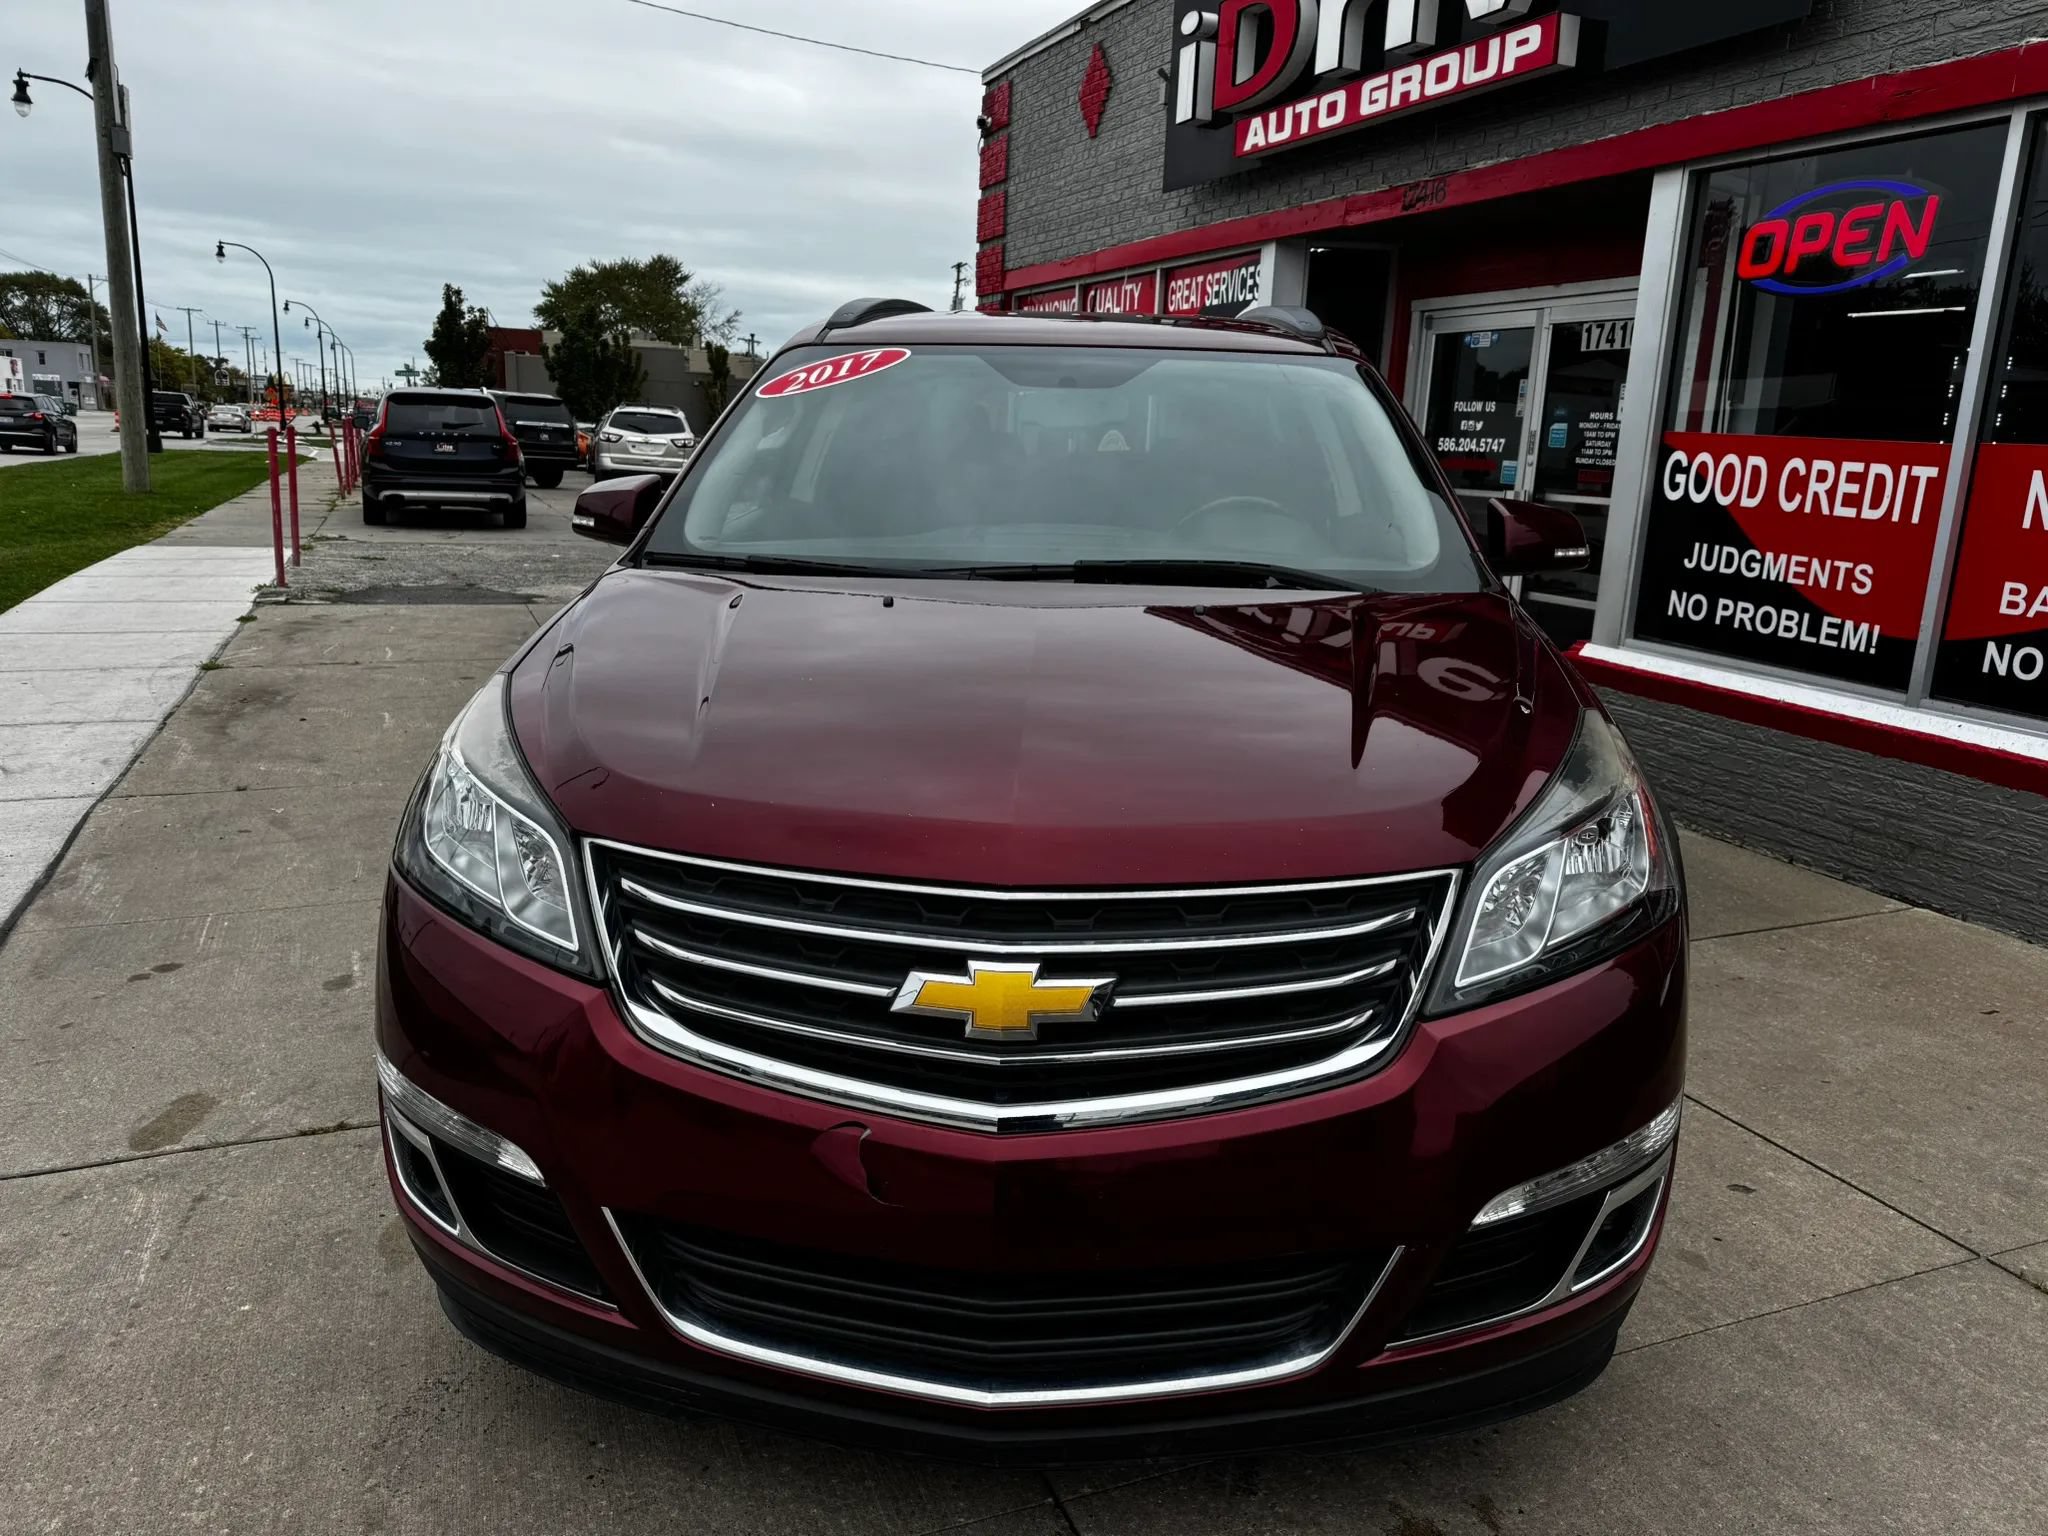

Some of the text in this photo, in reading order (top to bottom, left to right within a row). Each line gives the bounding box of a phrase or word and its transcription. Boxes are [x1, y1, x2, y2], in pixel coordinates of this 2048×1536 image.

[1243, 24, 1542, 152] AUTO GROUP
[1737, 194, 1940, 280] OPEN
[1168, 263, 1261, 312] GREAT SERVICES
[1585, 321, 1634, 350] 1741
[782, 351, 883, 393] 2017
[1454, 401, 1496, 412] FOLLOW US
[1590, 412, 1614, 420] HOURS
[1437, 437, 1506, 453] 586.204.5747
[1585, 440, 1612, 448] SATURDAY
[1663, 450, 1939, 524] GOOD CREDIT
[1683, 542, 1874, 595] JUDGMENTS
[1667, 590, 1881, 654] NO PROBLEM!
[1982, 641, 2044, 681] NO
